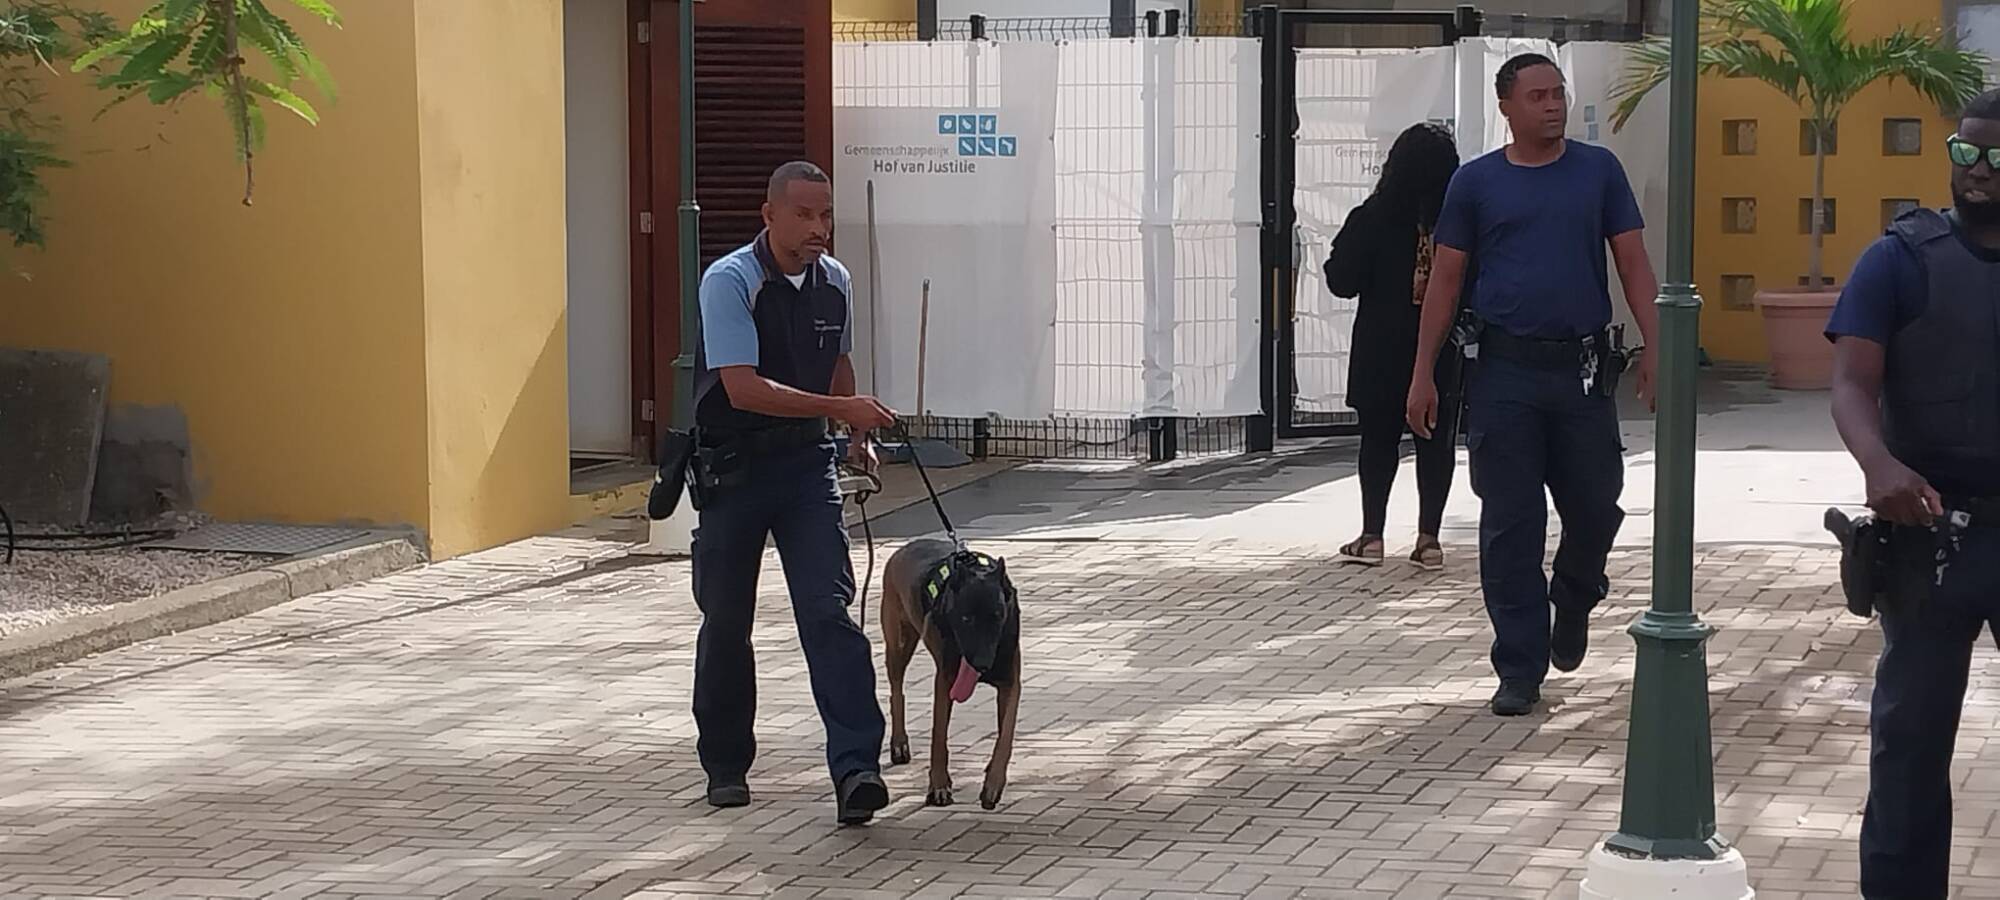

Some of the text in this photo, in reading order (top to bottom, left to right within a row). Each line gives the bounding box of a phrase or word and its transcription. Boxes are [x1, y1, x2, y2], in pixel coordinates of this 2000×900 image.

[873, 159, 976, 174] Hof van Justitie
[1361, 163, 1381, 175] Ho
